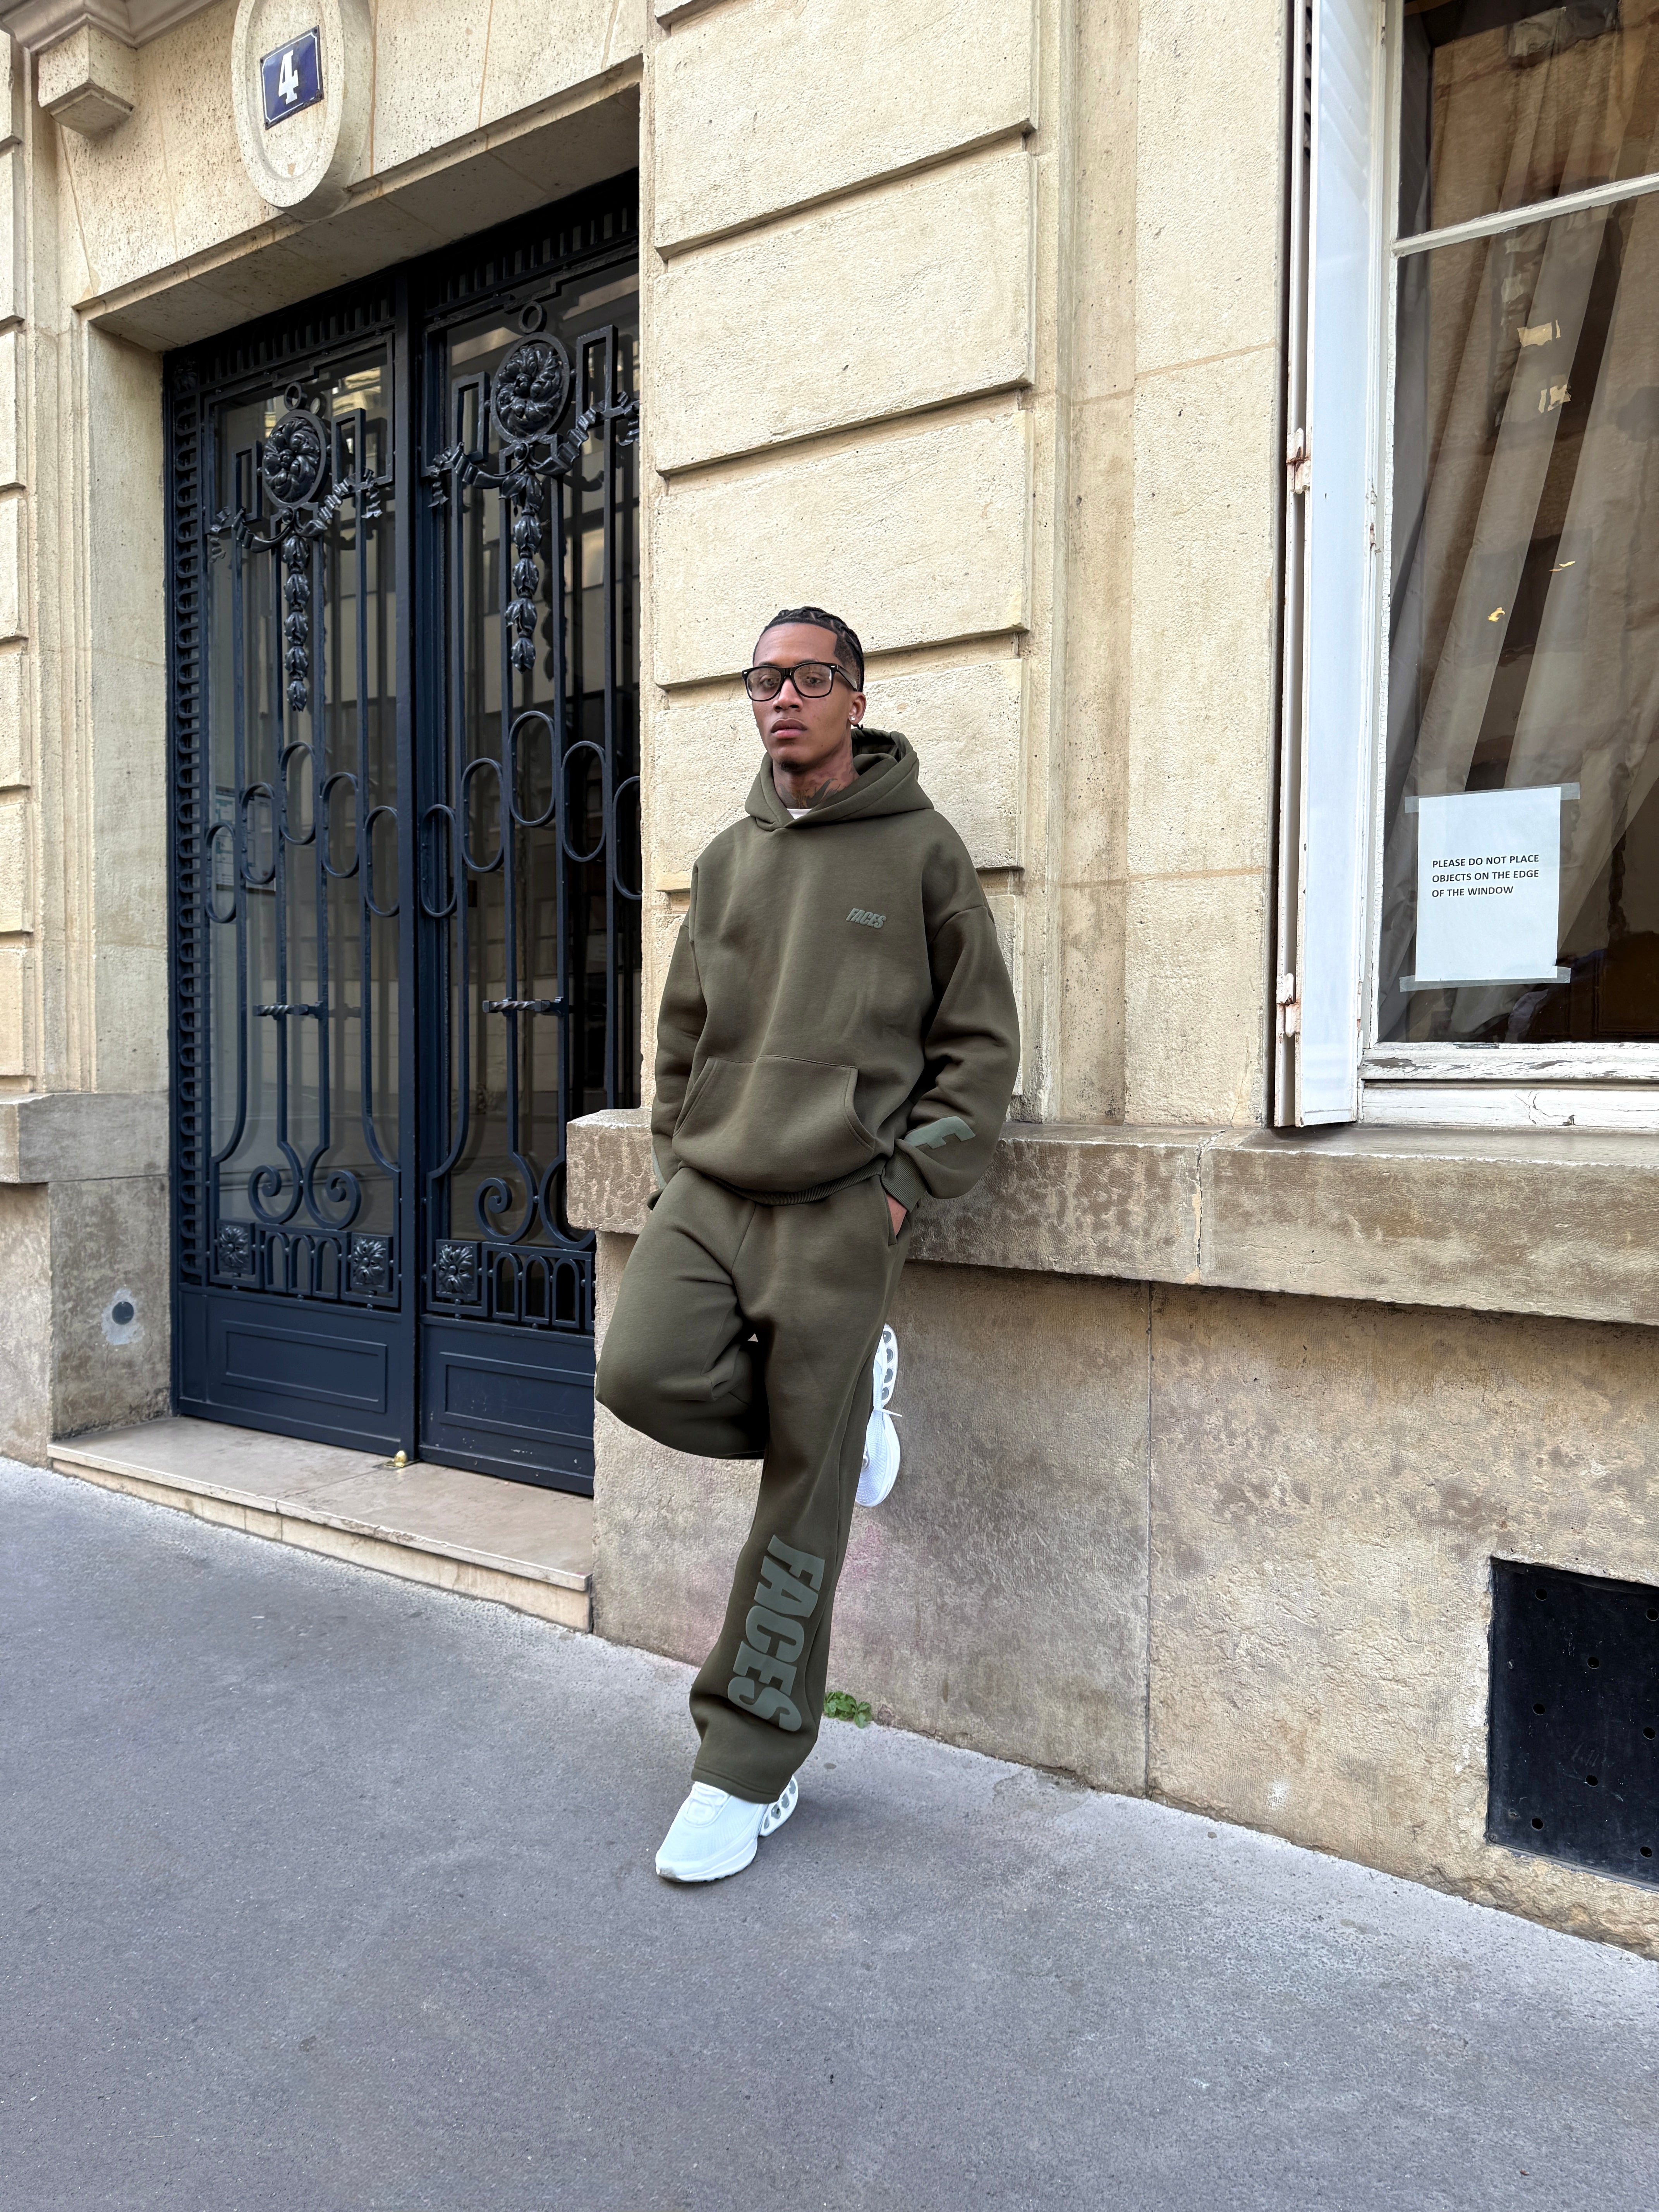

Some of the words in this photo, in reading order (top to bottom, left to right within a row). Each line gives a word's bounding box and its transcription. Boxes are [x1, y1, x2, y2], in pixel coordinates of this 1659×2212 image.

[278, 50, 299, 105] 4
[1433, 859, 1466, 868] PLEASE
[1468, 857, 1483, 866] DO
[1486, 856, 1507, 865] NOT
[1510, 854, 1539, 863] PLACE
[1432, 873, 1472, 883] OBJECTS
[1474, 872, 1489, 880] ON
[1491, 871, 1510, 879] THE
[1513, 870, 1539, 878] EDGE
[1446, 888, 1465, 896] THE
[1467, 886, 1513, 895] WINDOW
[846, 908, 887, 929] FACES
[727, 1534, 825, 1732] FACES
